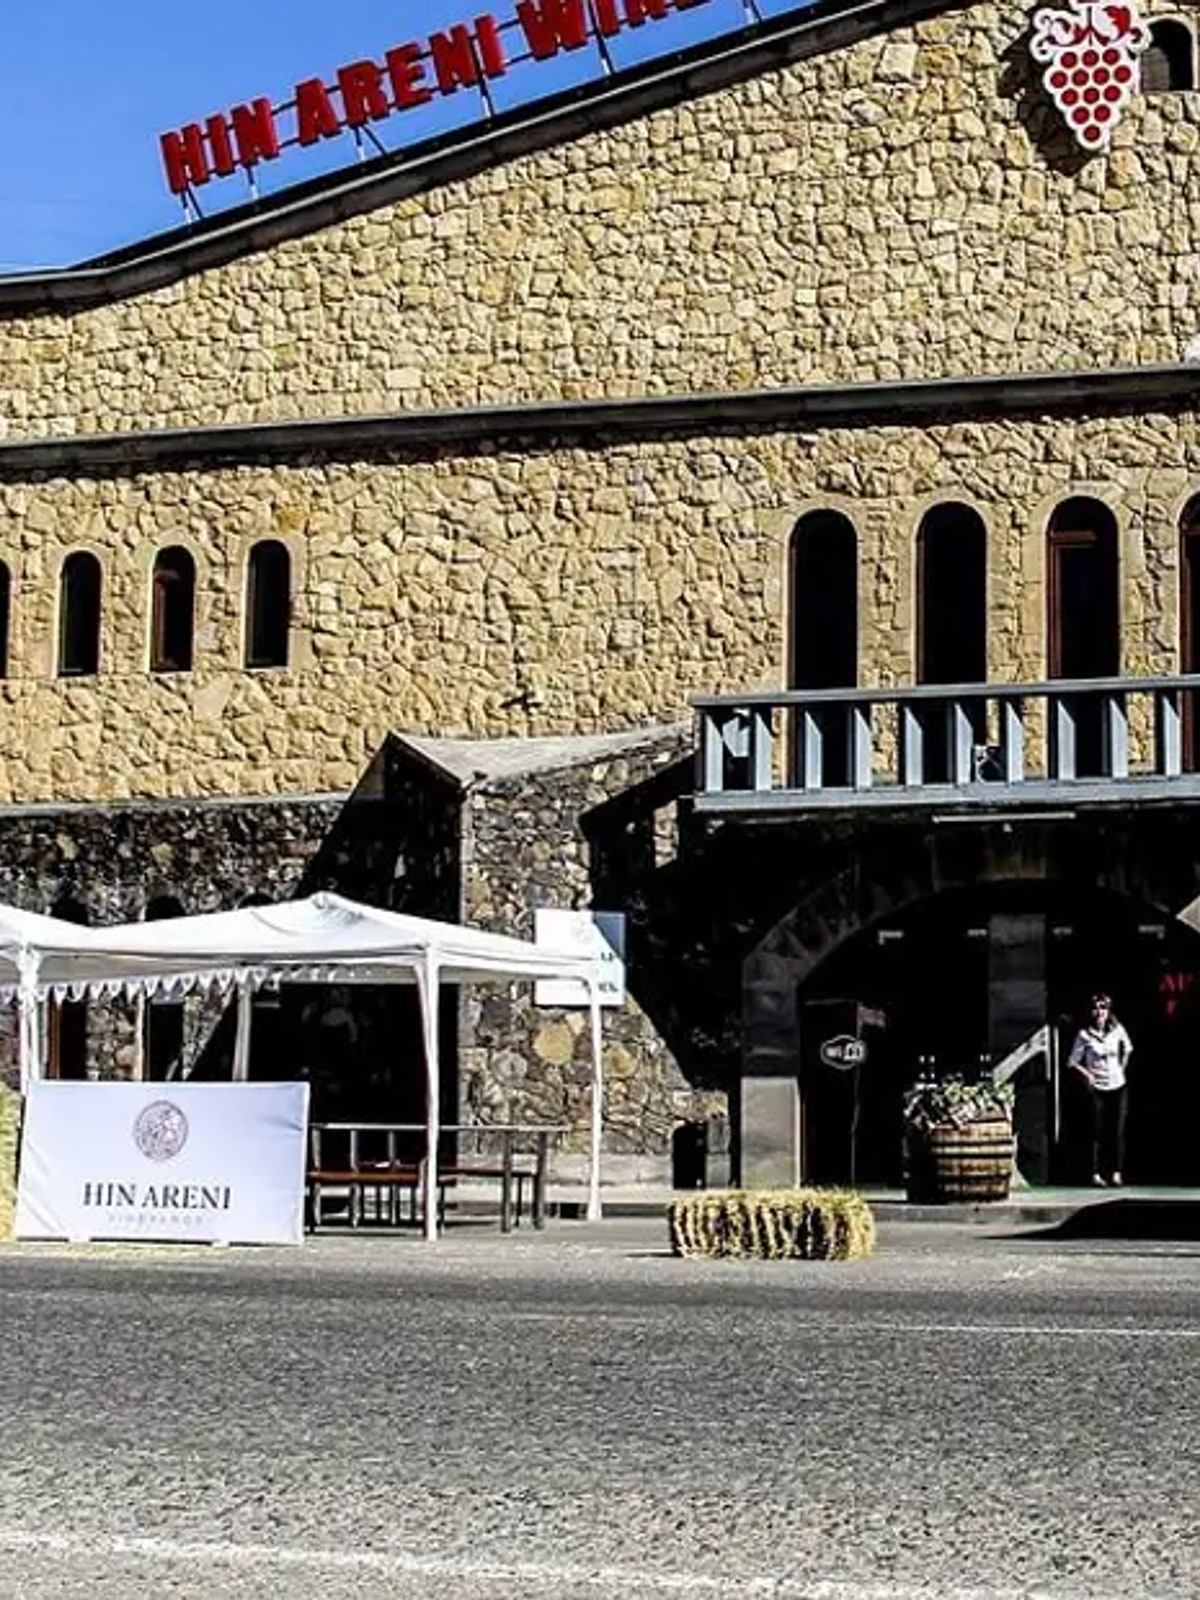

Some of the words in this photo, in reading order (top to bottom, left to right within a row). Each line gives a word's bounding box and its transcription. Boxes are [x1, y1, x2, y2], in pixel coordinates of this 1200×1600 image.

[161, 97, 279, 194] HIN
[295, 14, 507, 147] ARENI
[517, 0, 712, 60] WI
[83, 1182, 136, 1206] HIN
[141, 1184, 231, 1210] ARENI
